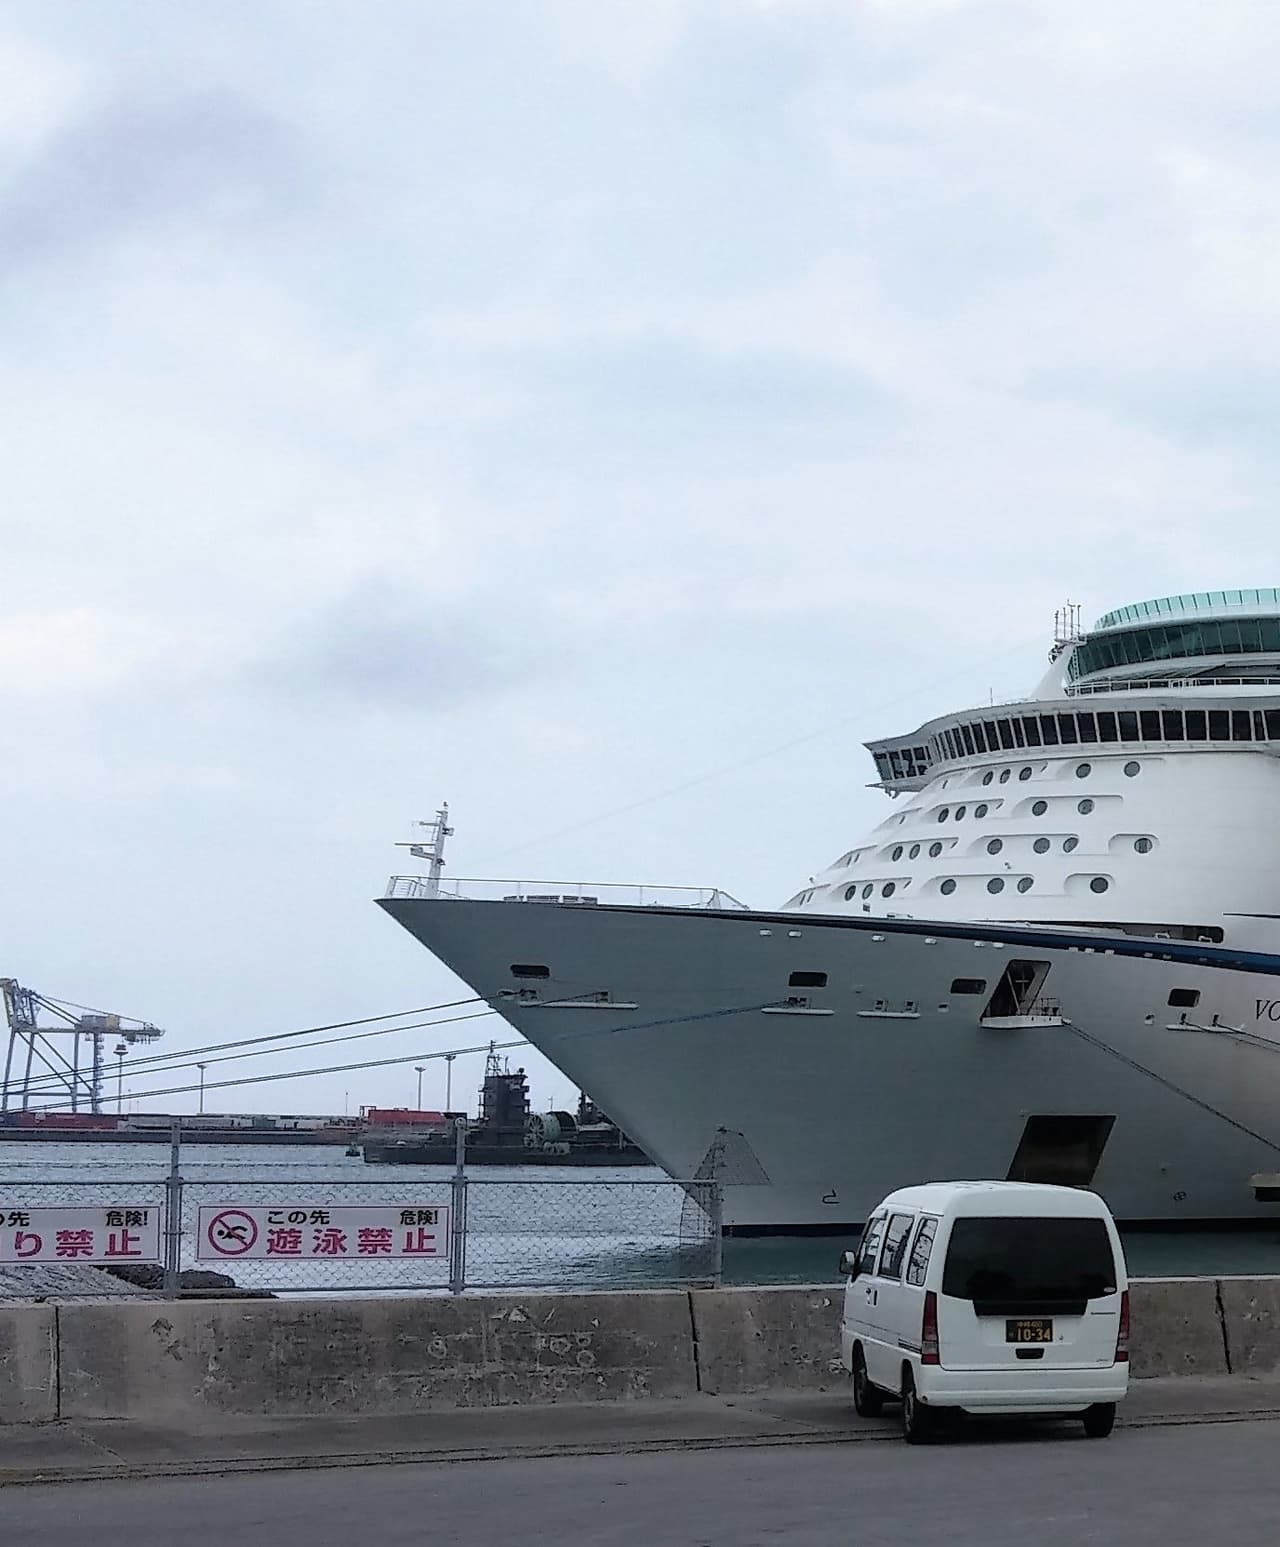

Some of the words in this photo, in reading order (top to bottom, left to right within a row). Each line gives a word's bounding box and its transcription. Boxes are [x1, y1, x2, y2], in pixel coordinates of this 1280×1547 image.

[0, 1211, 30, 1227] 先
[105, 1210, 148, 1227] 危険!
[267, 1209, 330, 1225] この先
[400, 1209, 438, 1225] 危険!
[14, 1229, 142, 1258] り禁止
[267, 1227, 437, 1255] 遊泳禁止
[1017, 1328, 1051, 1341] 10-34
